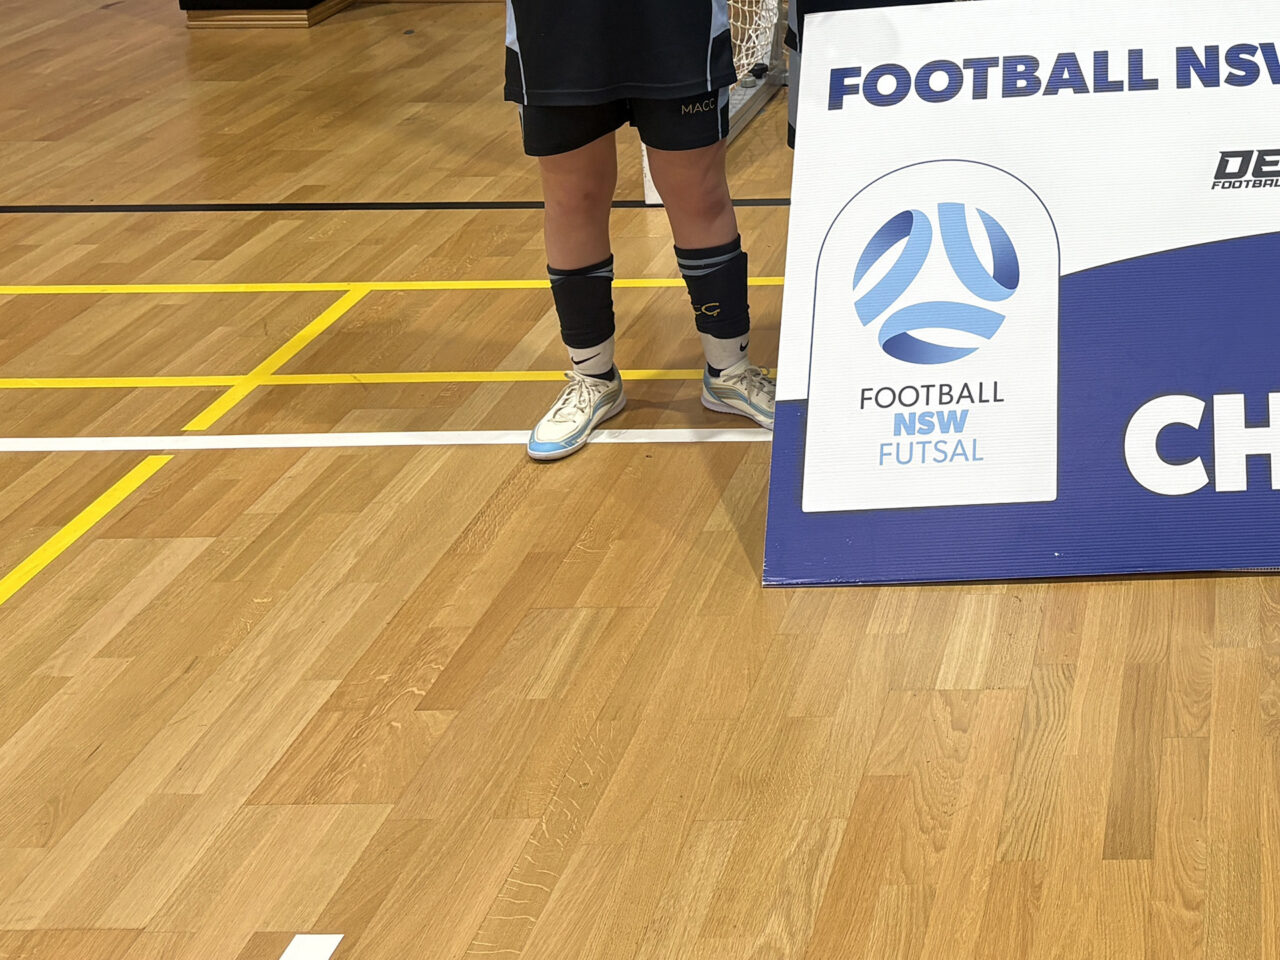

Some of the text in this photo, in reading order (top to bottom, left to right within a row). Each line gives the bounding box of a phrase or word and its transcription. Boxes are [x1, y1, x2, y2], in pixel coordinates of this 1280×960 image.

[827, 48, 1159, 111] FOOTBALL
[682, 98, 715, 115] MACC
[860, 380, 1005, 410] FOOTBALL
[893, 409, 970, 437] NSW
[879, 438, 985, 467] FUTSAL
